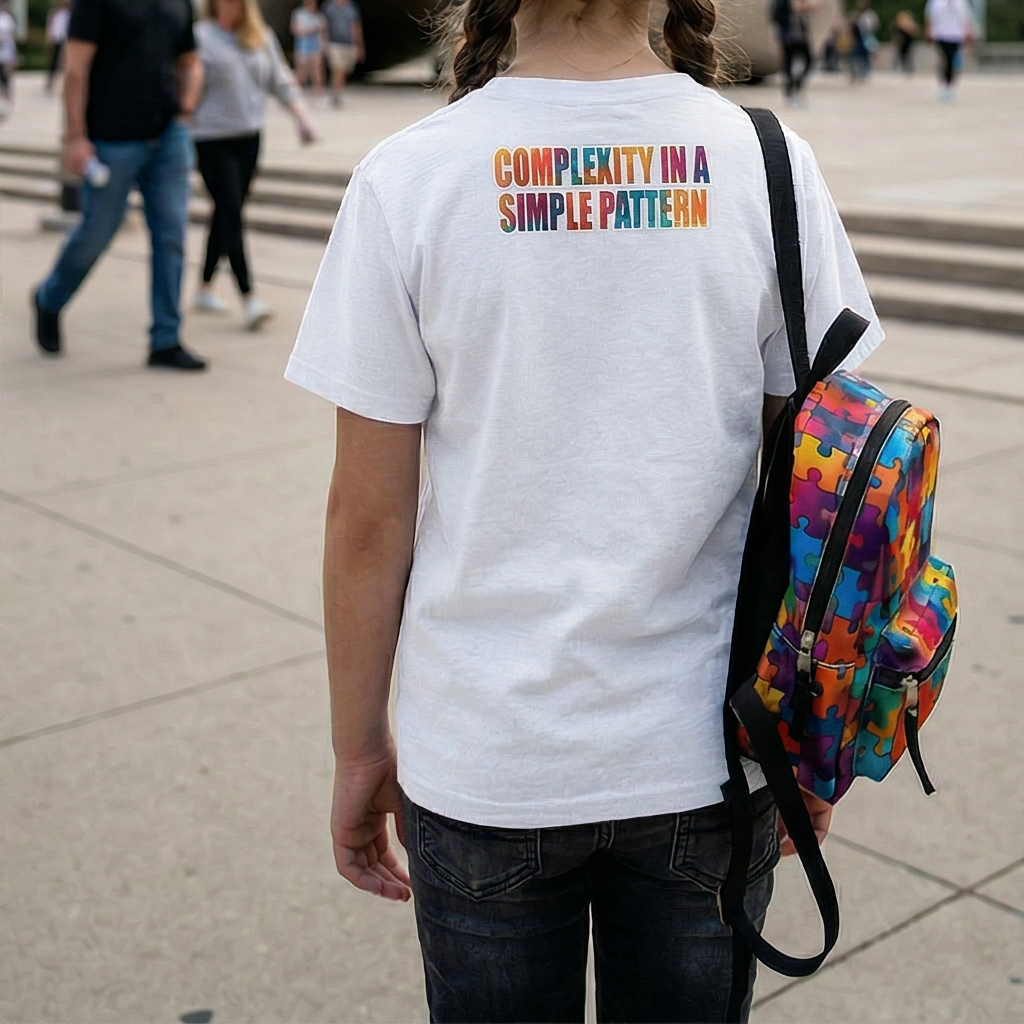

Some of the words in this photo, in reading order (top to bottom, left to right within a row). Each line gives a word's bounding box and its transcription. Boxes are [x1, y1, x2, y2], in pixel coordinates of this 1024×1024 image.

[494, 145, 654, 187] COMPLEXITY
[660, 145, 687, 184] IN
[693, 145, 711, 184] A
[498, 192, 593, 233] SIMPLE
[599, 189, 708, 230] PATTERN
